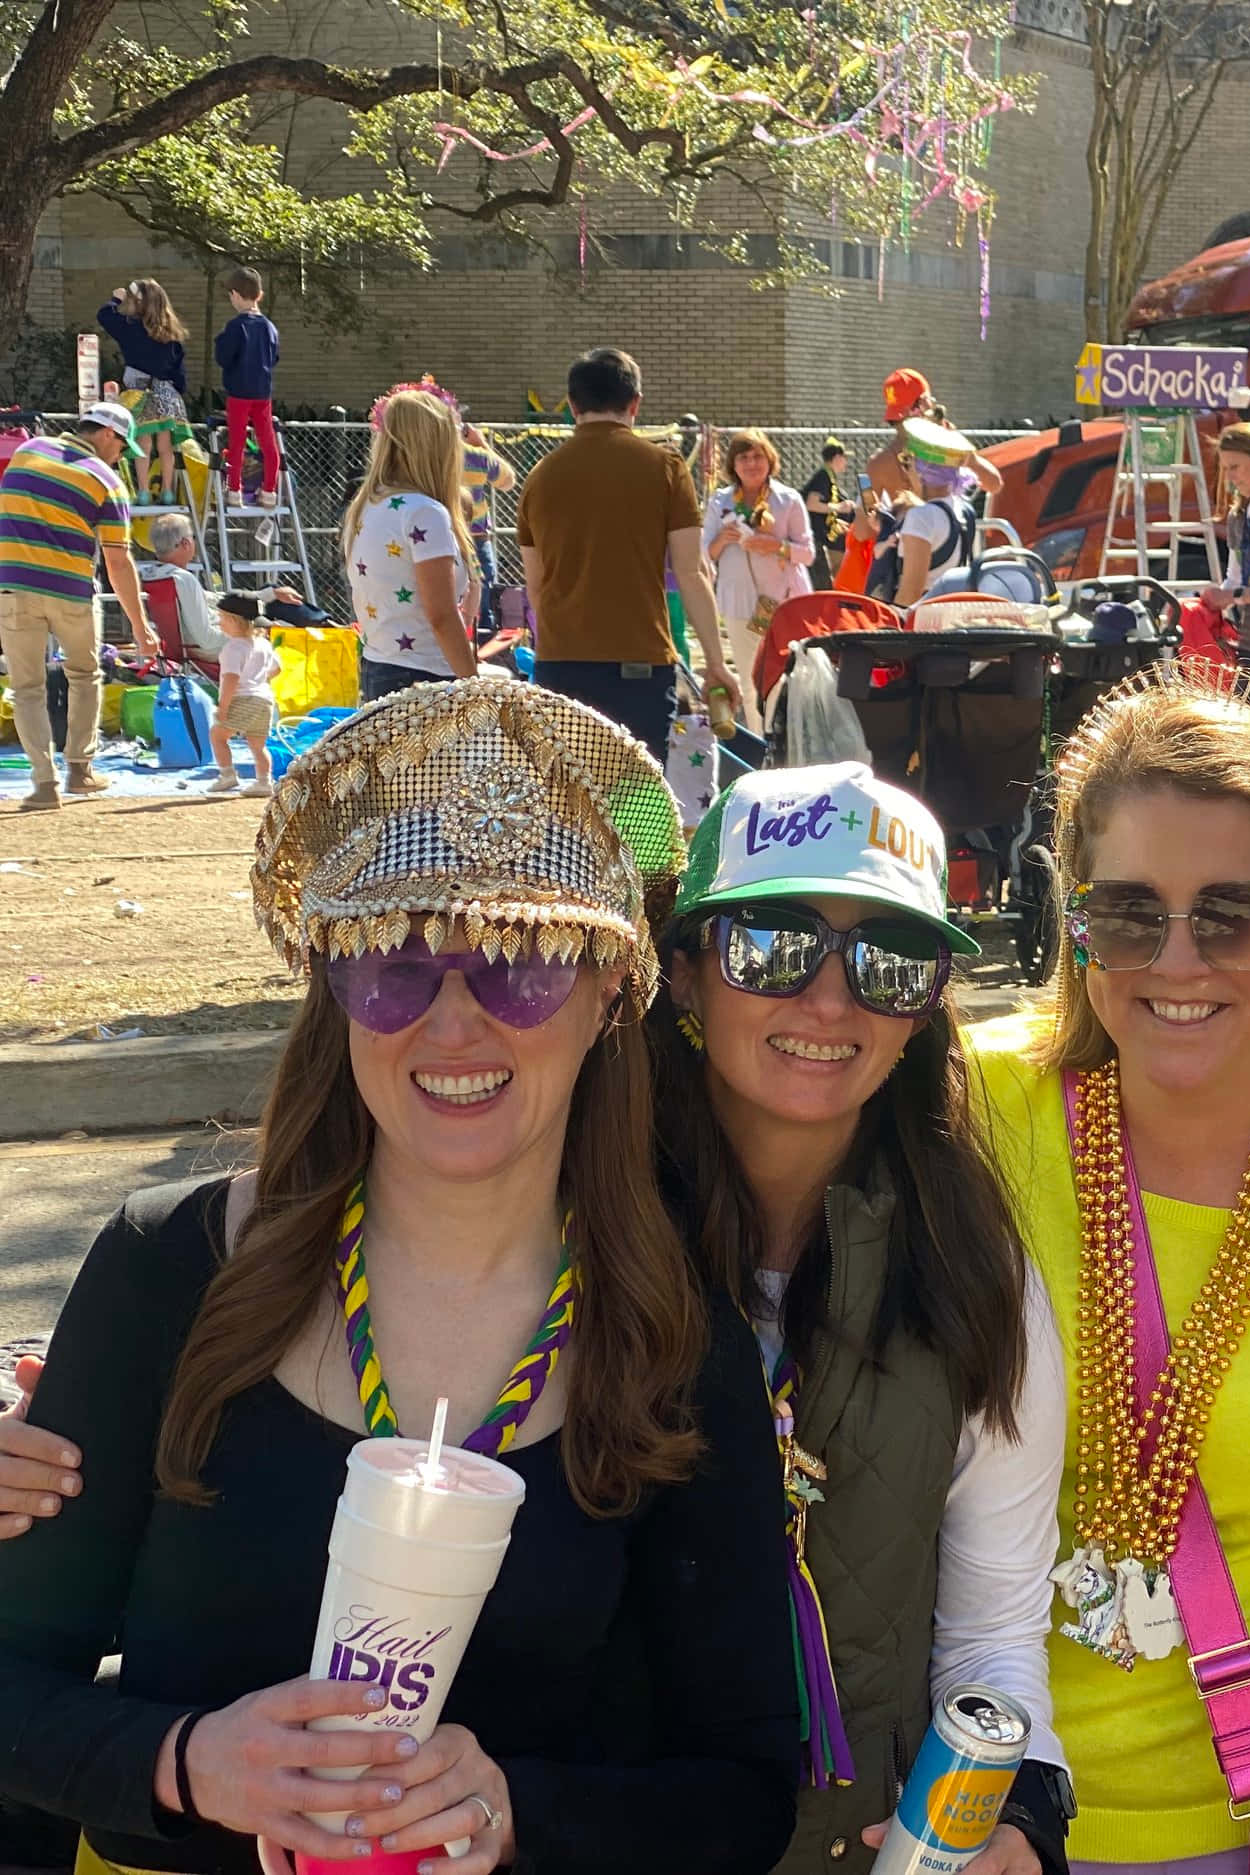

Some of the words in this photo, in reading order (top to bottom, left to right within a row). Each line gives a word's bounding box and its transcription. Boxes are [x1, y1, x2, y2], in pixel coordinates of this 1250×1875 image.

[746, 794, 838, 856] Last
[333, 1604, 452, 1660] Hail
[373, 1714, 420, 1727] 2022
[943, 1804, 999, 1823] NOO
[919, 1855, 953, 1873] VODKA
